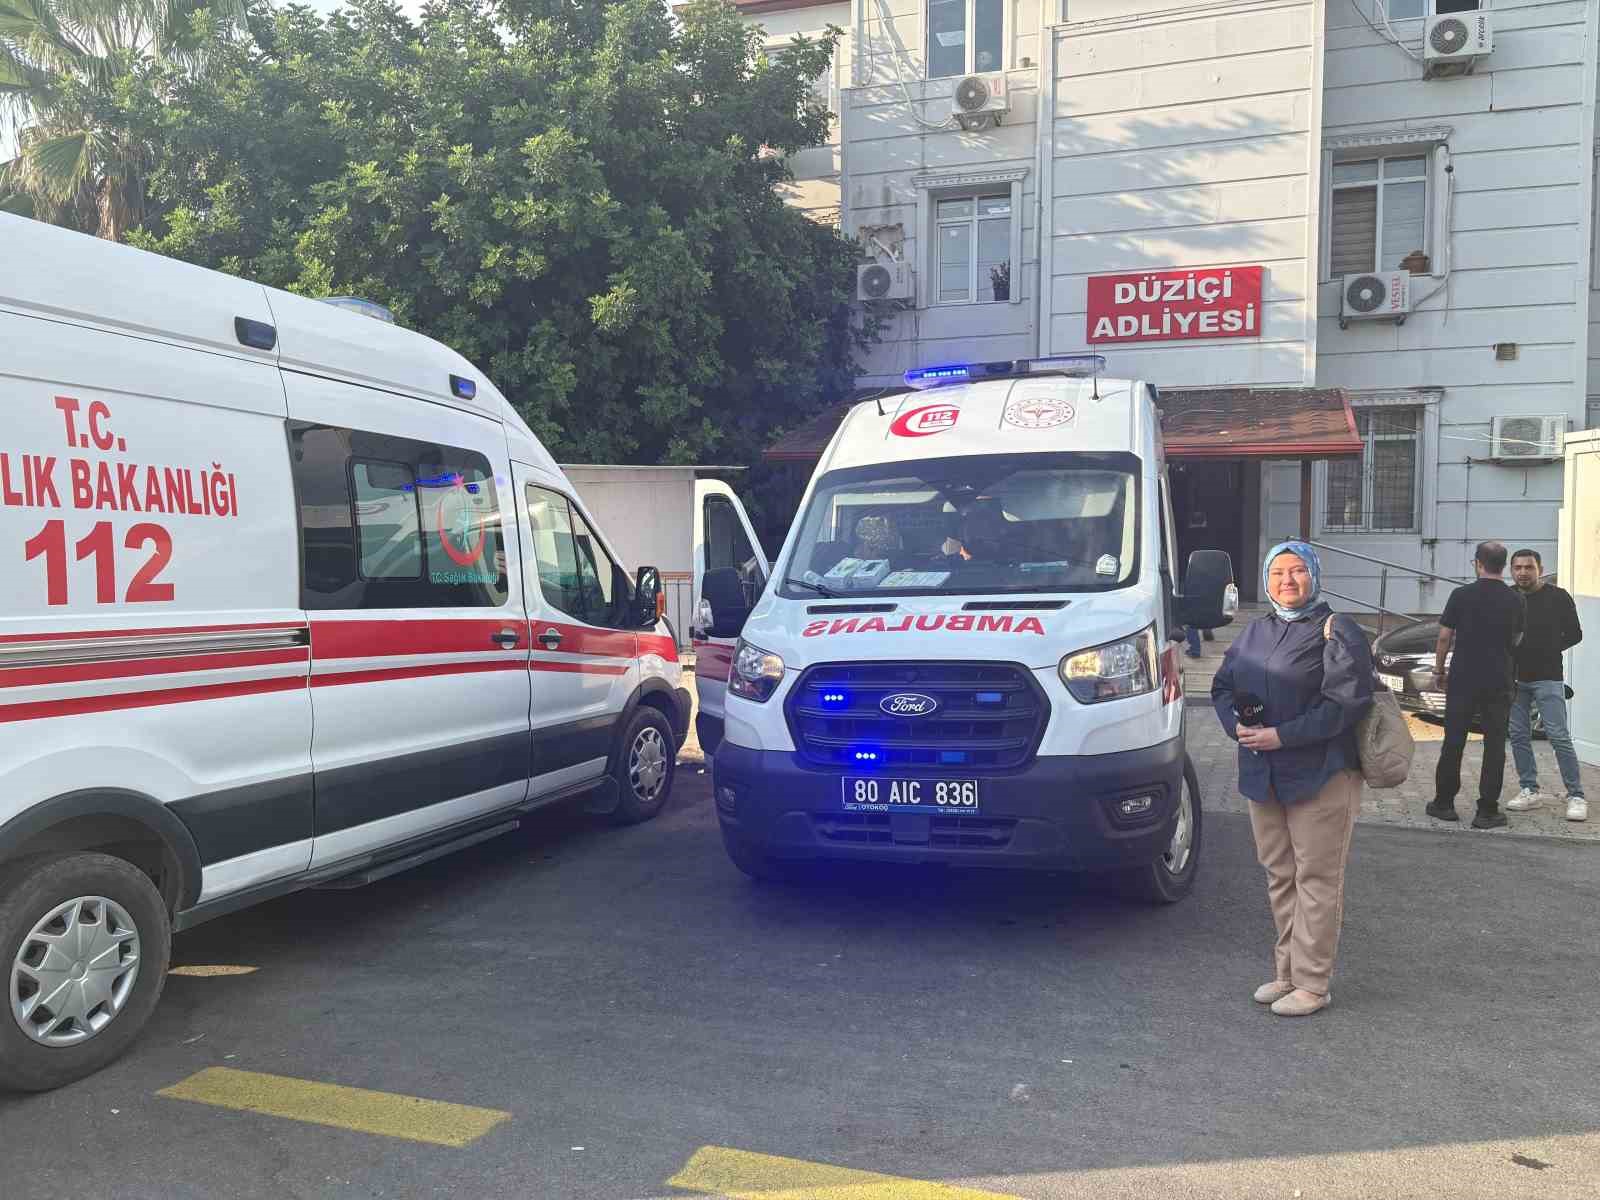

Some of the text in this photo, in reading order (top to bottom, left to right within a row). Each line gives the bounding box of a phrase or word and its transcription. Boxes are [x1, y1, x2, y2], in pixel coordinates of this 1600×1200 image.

[1114, 270, 1232, 305] DÜZİÇİ
[1091, 303, 1255, 338] ADLİYESİ
[54, 395, 127, 452] T.C.
[70, 459, 238, 517] BAKANLIĞI
[25, 519, 175, 606] 112
[890, 696, 926, 712] Ford
[854, 780, 974, 806] 80 AIC 836
